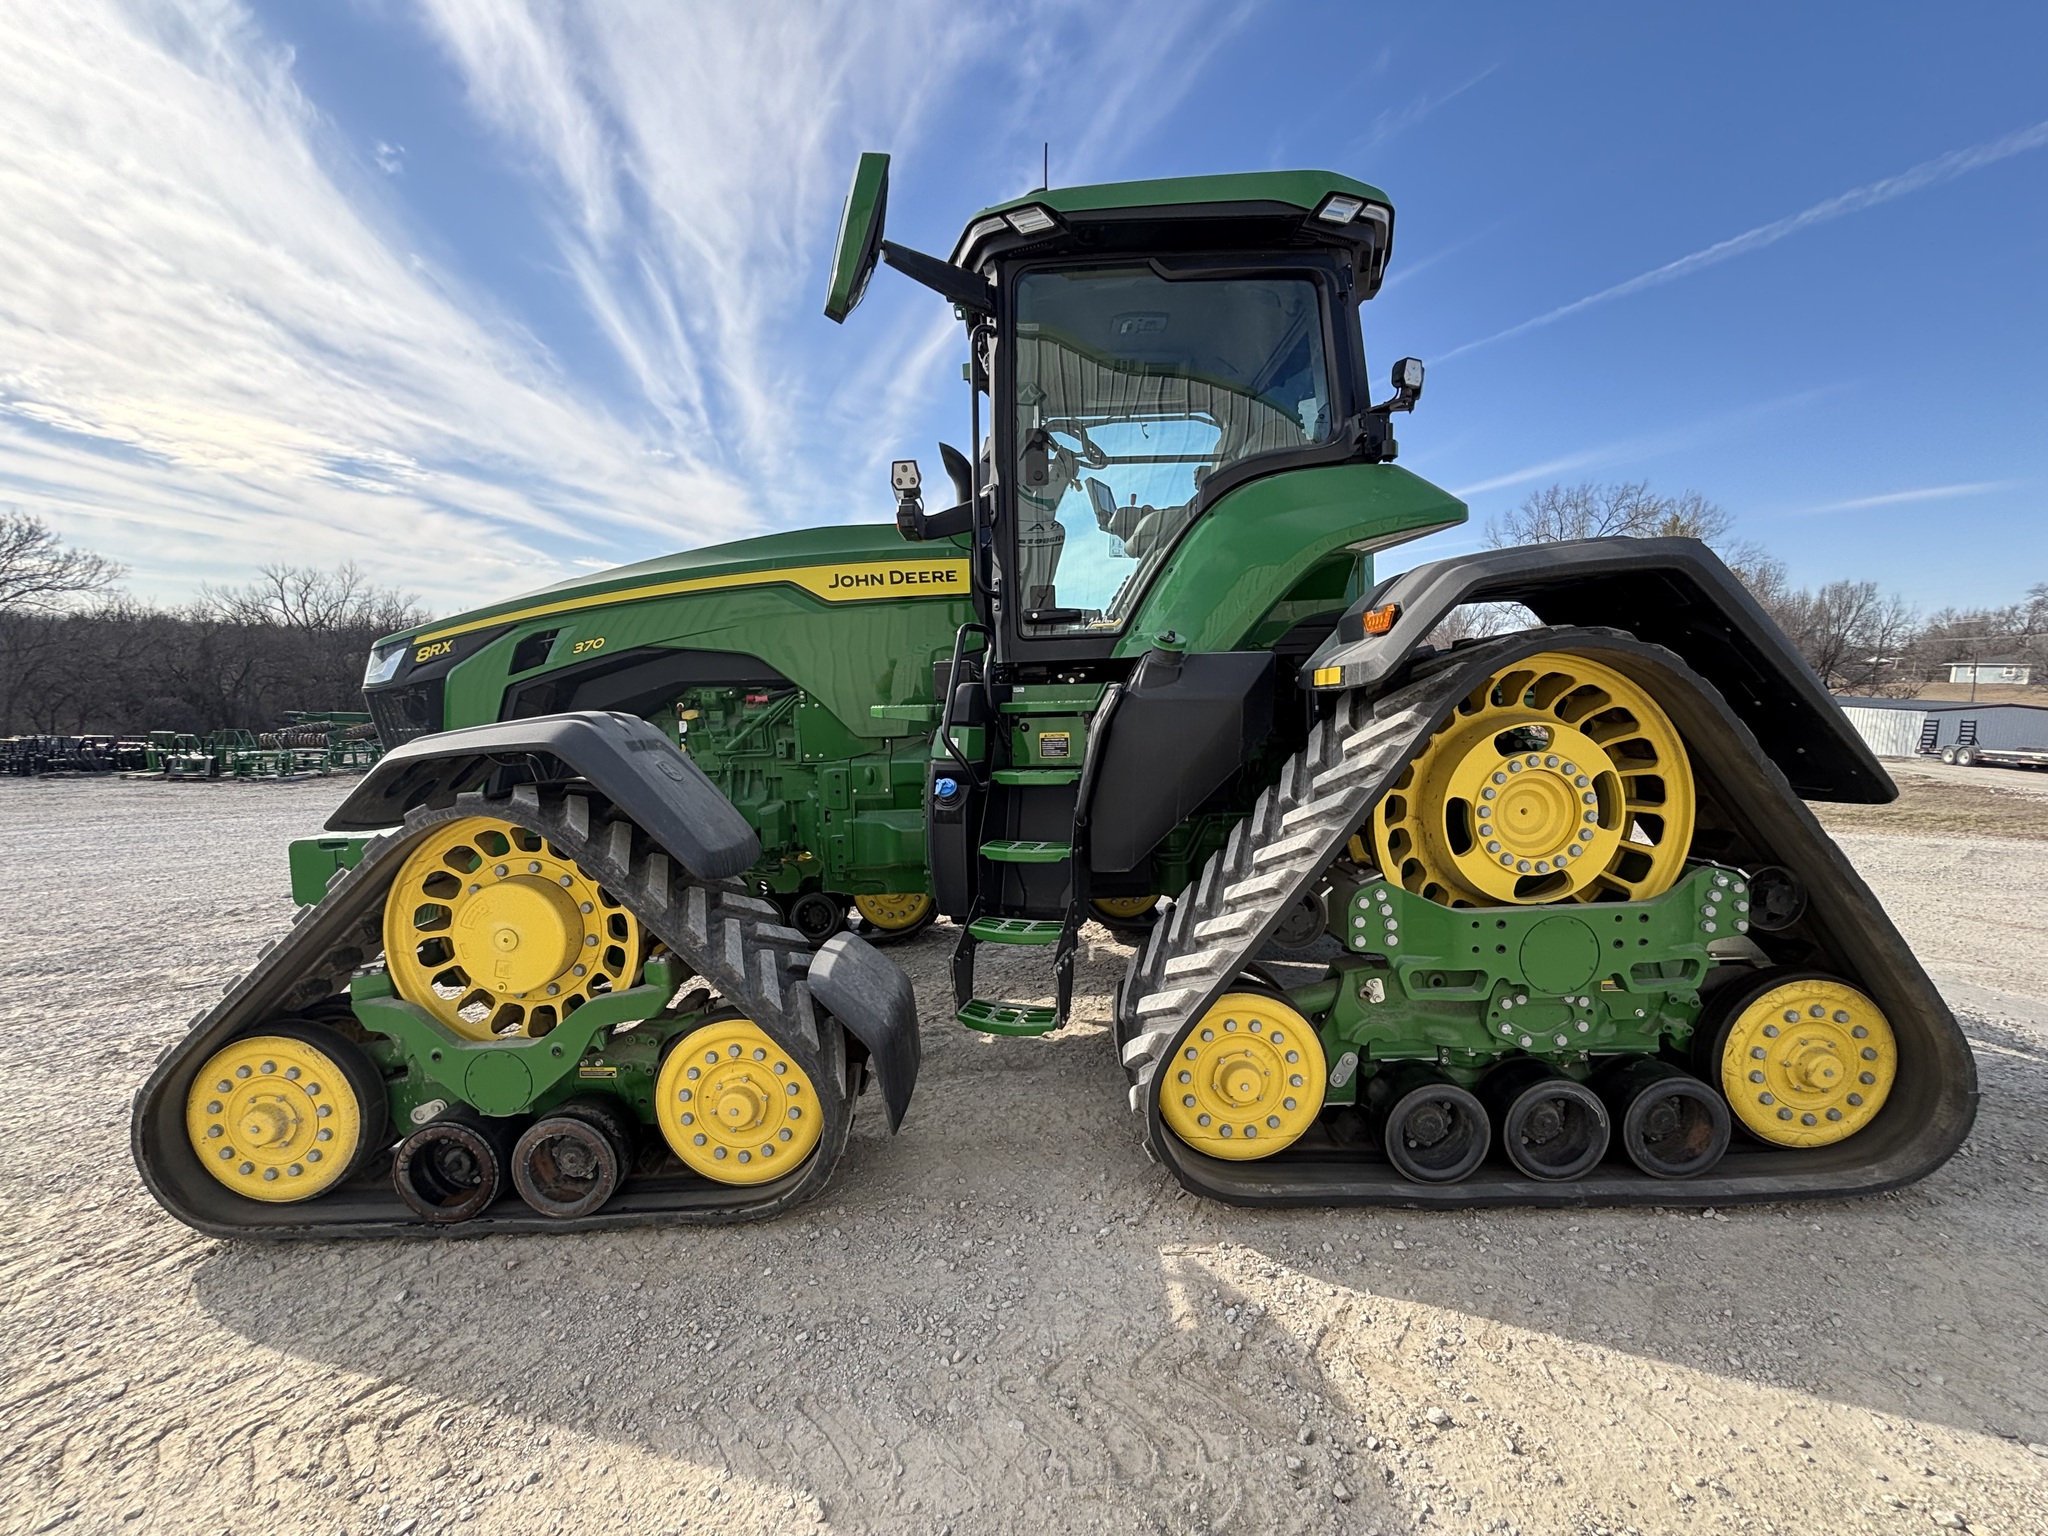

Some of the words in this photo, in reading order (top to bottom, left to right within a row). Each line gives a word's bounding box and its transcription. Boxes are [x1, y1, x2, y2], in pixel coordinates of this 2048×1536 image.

[828, 573, 885, 589] JOHN
[889, 570, 958, 585] DEERE
[415, 639, 454, 663] 8RX
[572, 637, 605, 655] 370
